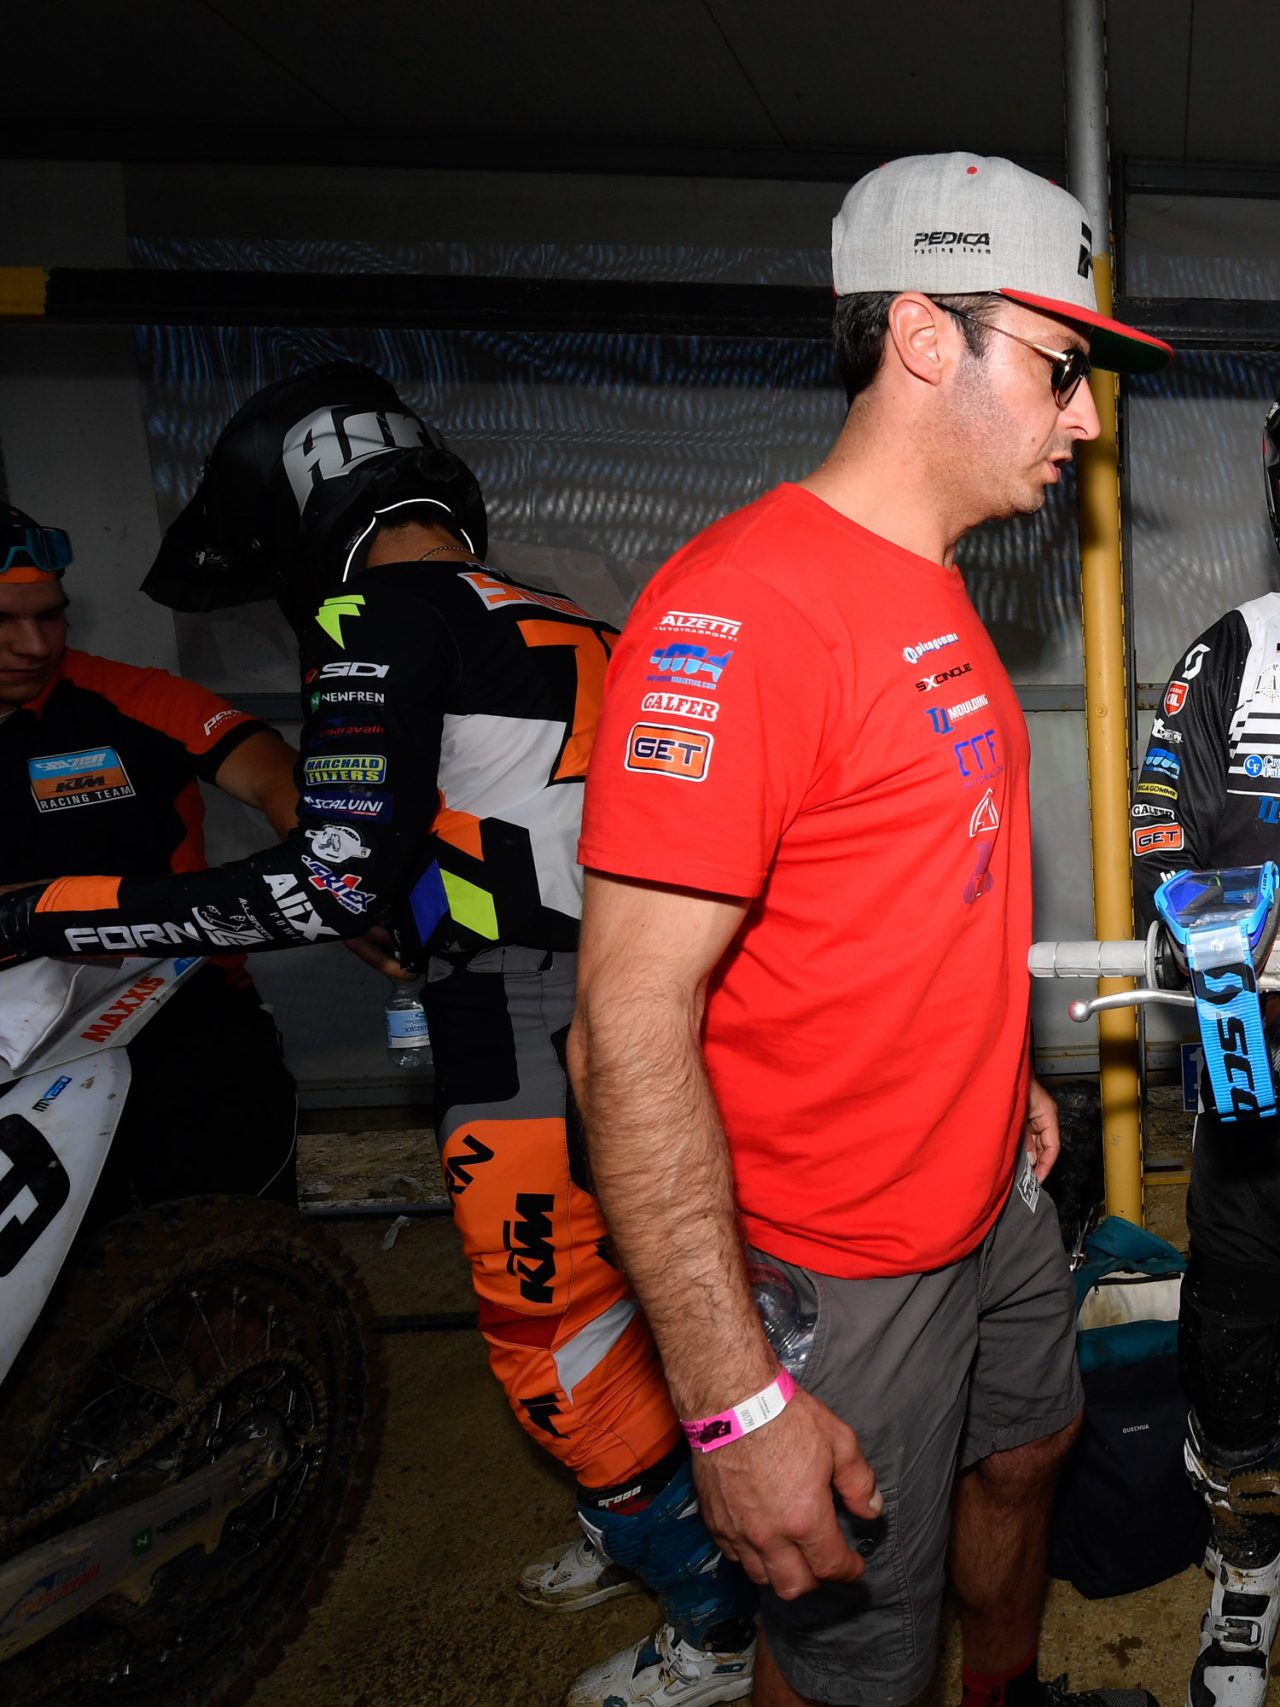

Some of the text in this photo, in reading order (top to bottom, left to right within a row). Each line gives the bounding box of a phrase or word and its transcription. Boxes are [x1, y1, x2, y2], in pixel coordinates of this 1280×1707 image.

[914, 231, 990, 246] PEDICA
[321, 691, 385, 704] NEWFREN
[634, 737, 702, 766] GET
[306, 758, 380, 772] MARCHALD
[309, 770, 380, 784] FILTERS
[40, 786, 132, 811] RACING TEAM
[311, 799, 384, 812] SCALVINI
[1138, 831, 1178, 847] GET
[80, 974, 166, 1043] MAXXIS
[503, 1192, 557, 1304] KTM
